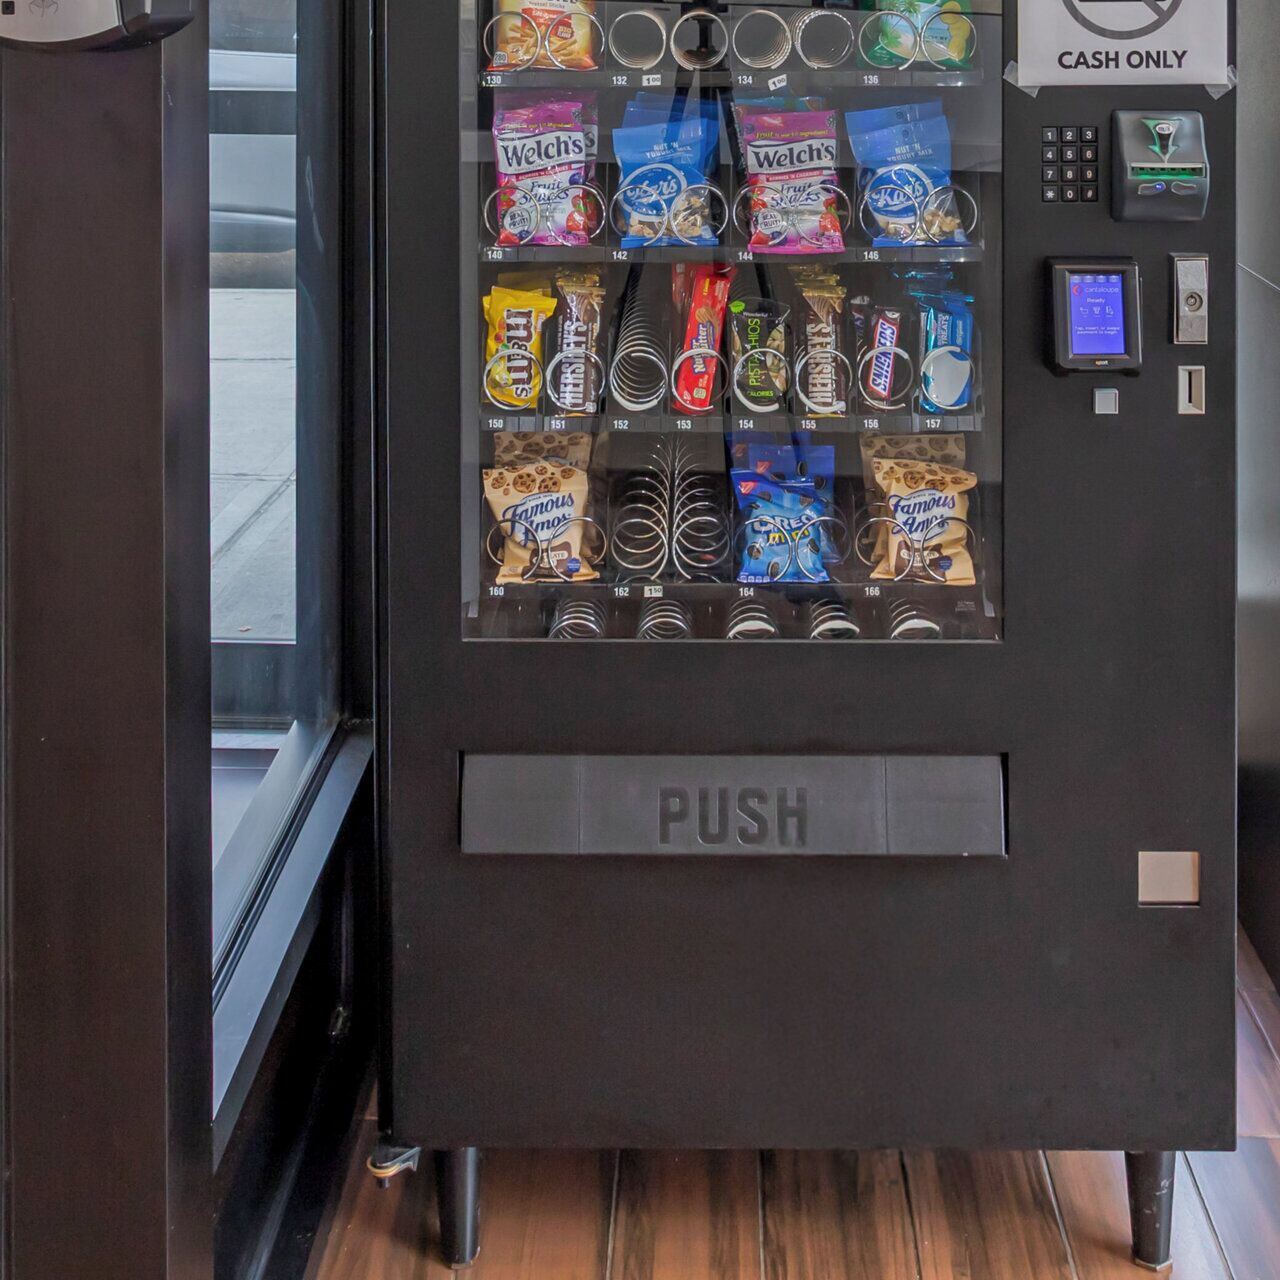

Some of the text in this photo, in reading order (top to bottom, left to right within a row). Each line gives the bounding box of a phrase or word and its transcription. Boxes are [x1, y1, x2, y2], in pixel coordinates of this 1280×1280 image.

[1057, 50, 1188, 69] CASH ONLY
[486, 75, 502, 85] 130
[612, 75, 627, 85] 132
[737, 75, 753, 85] 134
[863, 75, 879, 84] 136
[501, 135, 583, 167] Welch's
[751, 142, 835, 168] Welch's
[487, 250, 503, 259] 140
[612, 250, 628, 260] 142
[738, 251, 754, 261] 144
[863, 250, 879, 260] 146
[487, 419, 504, 429] 150
[550, 420, 566, 429] 151
[613, 420, 629, 429] 152
[676, 420, 692, 429] 153
[738, 420, 754, 429] 154
[801, 420, 817, 429] 155
[863, 419, 879, 429] 156
[925, 419, 941, 429] 157
[888, 494, 956, 516] Famous
[502, 492, 575, 537] Famous
[488, 586, 504, 596] 160
[614, 587, 629, 597] 162
[738, 587, 754, 597] 164
[864, 586, 880, 596] 166
[657, 786, 808, 847] PUSH
